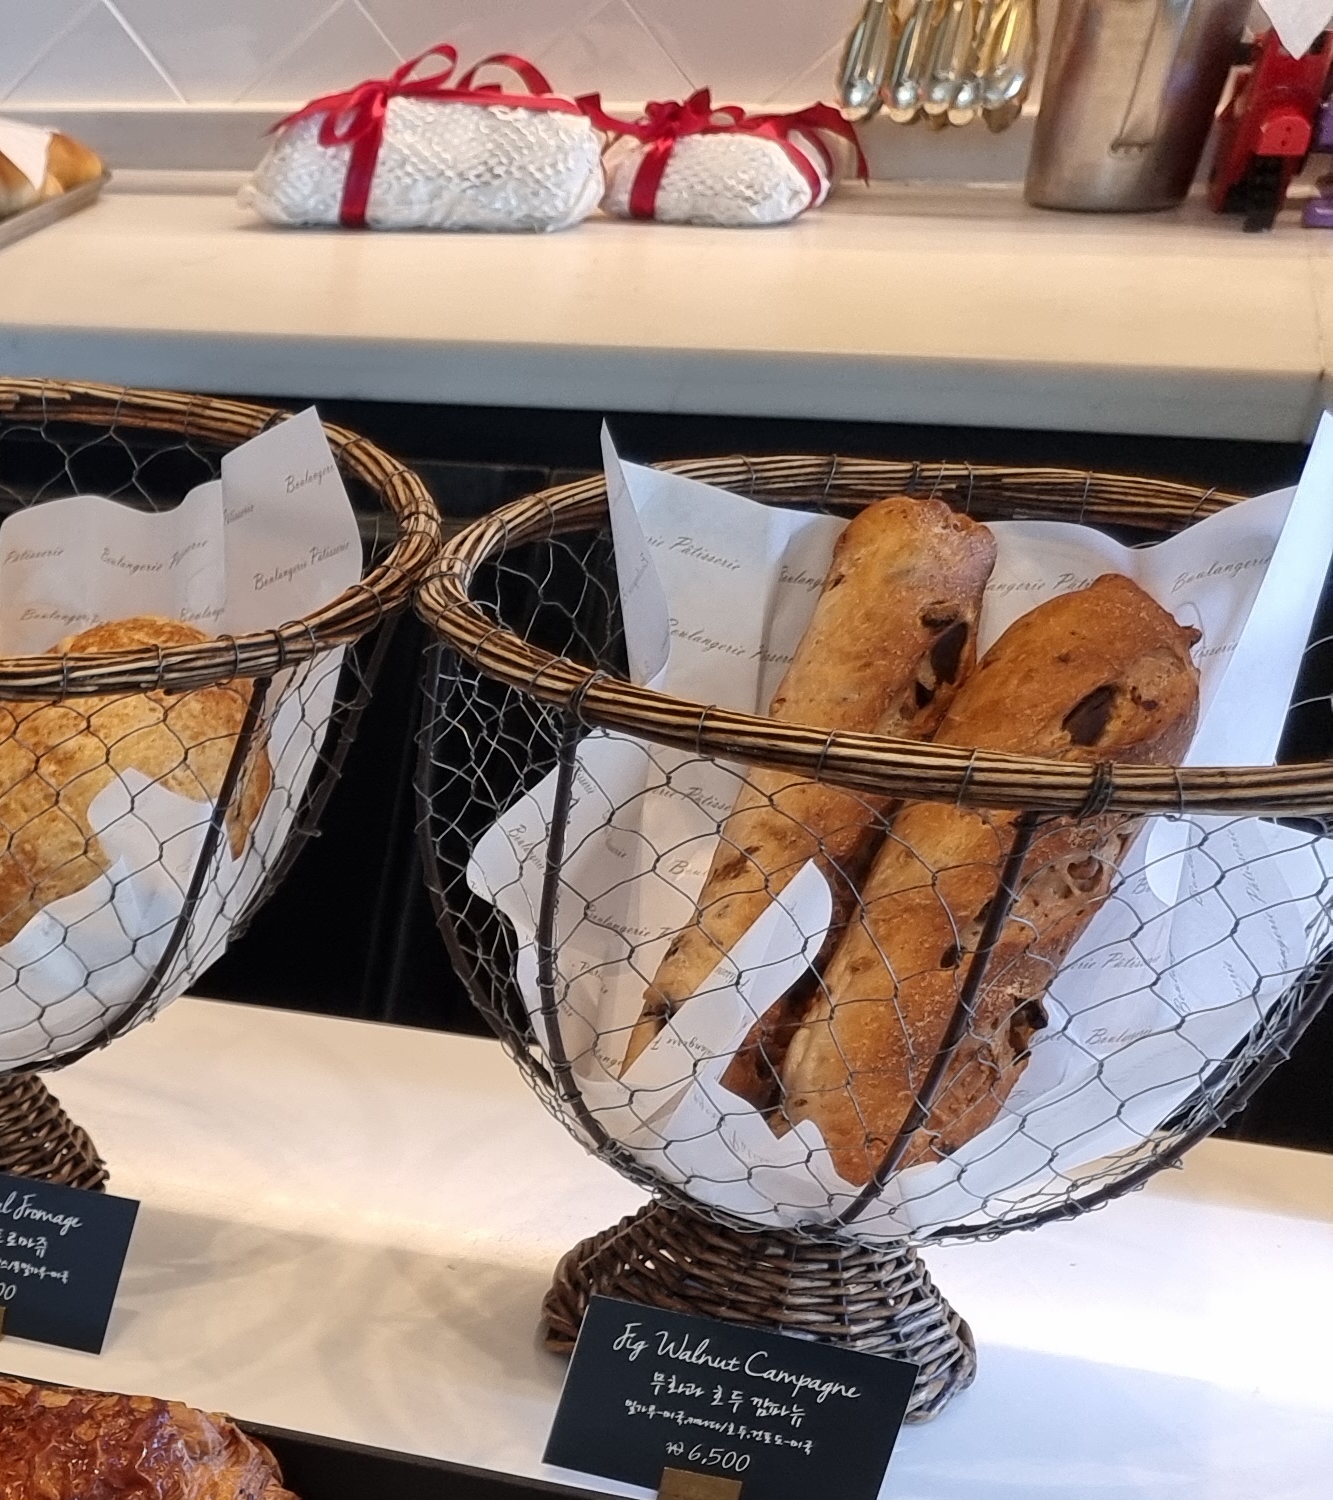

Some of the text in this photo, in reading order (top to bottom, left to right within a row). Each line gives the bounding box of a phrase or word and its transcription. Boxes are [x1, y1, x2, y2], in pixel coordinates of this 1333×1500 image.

[13, 1193, 83, 1236] Fromage
[612, 1322, 861, 1402] Fig Walnut Campagne
